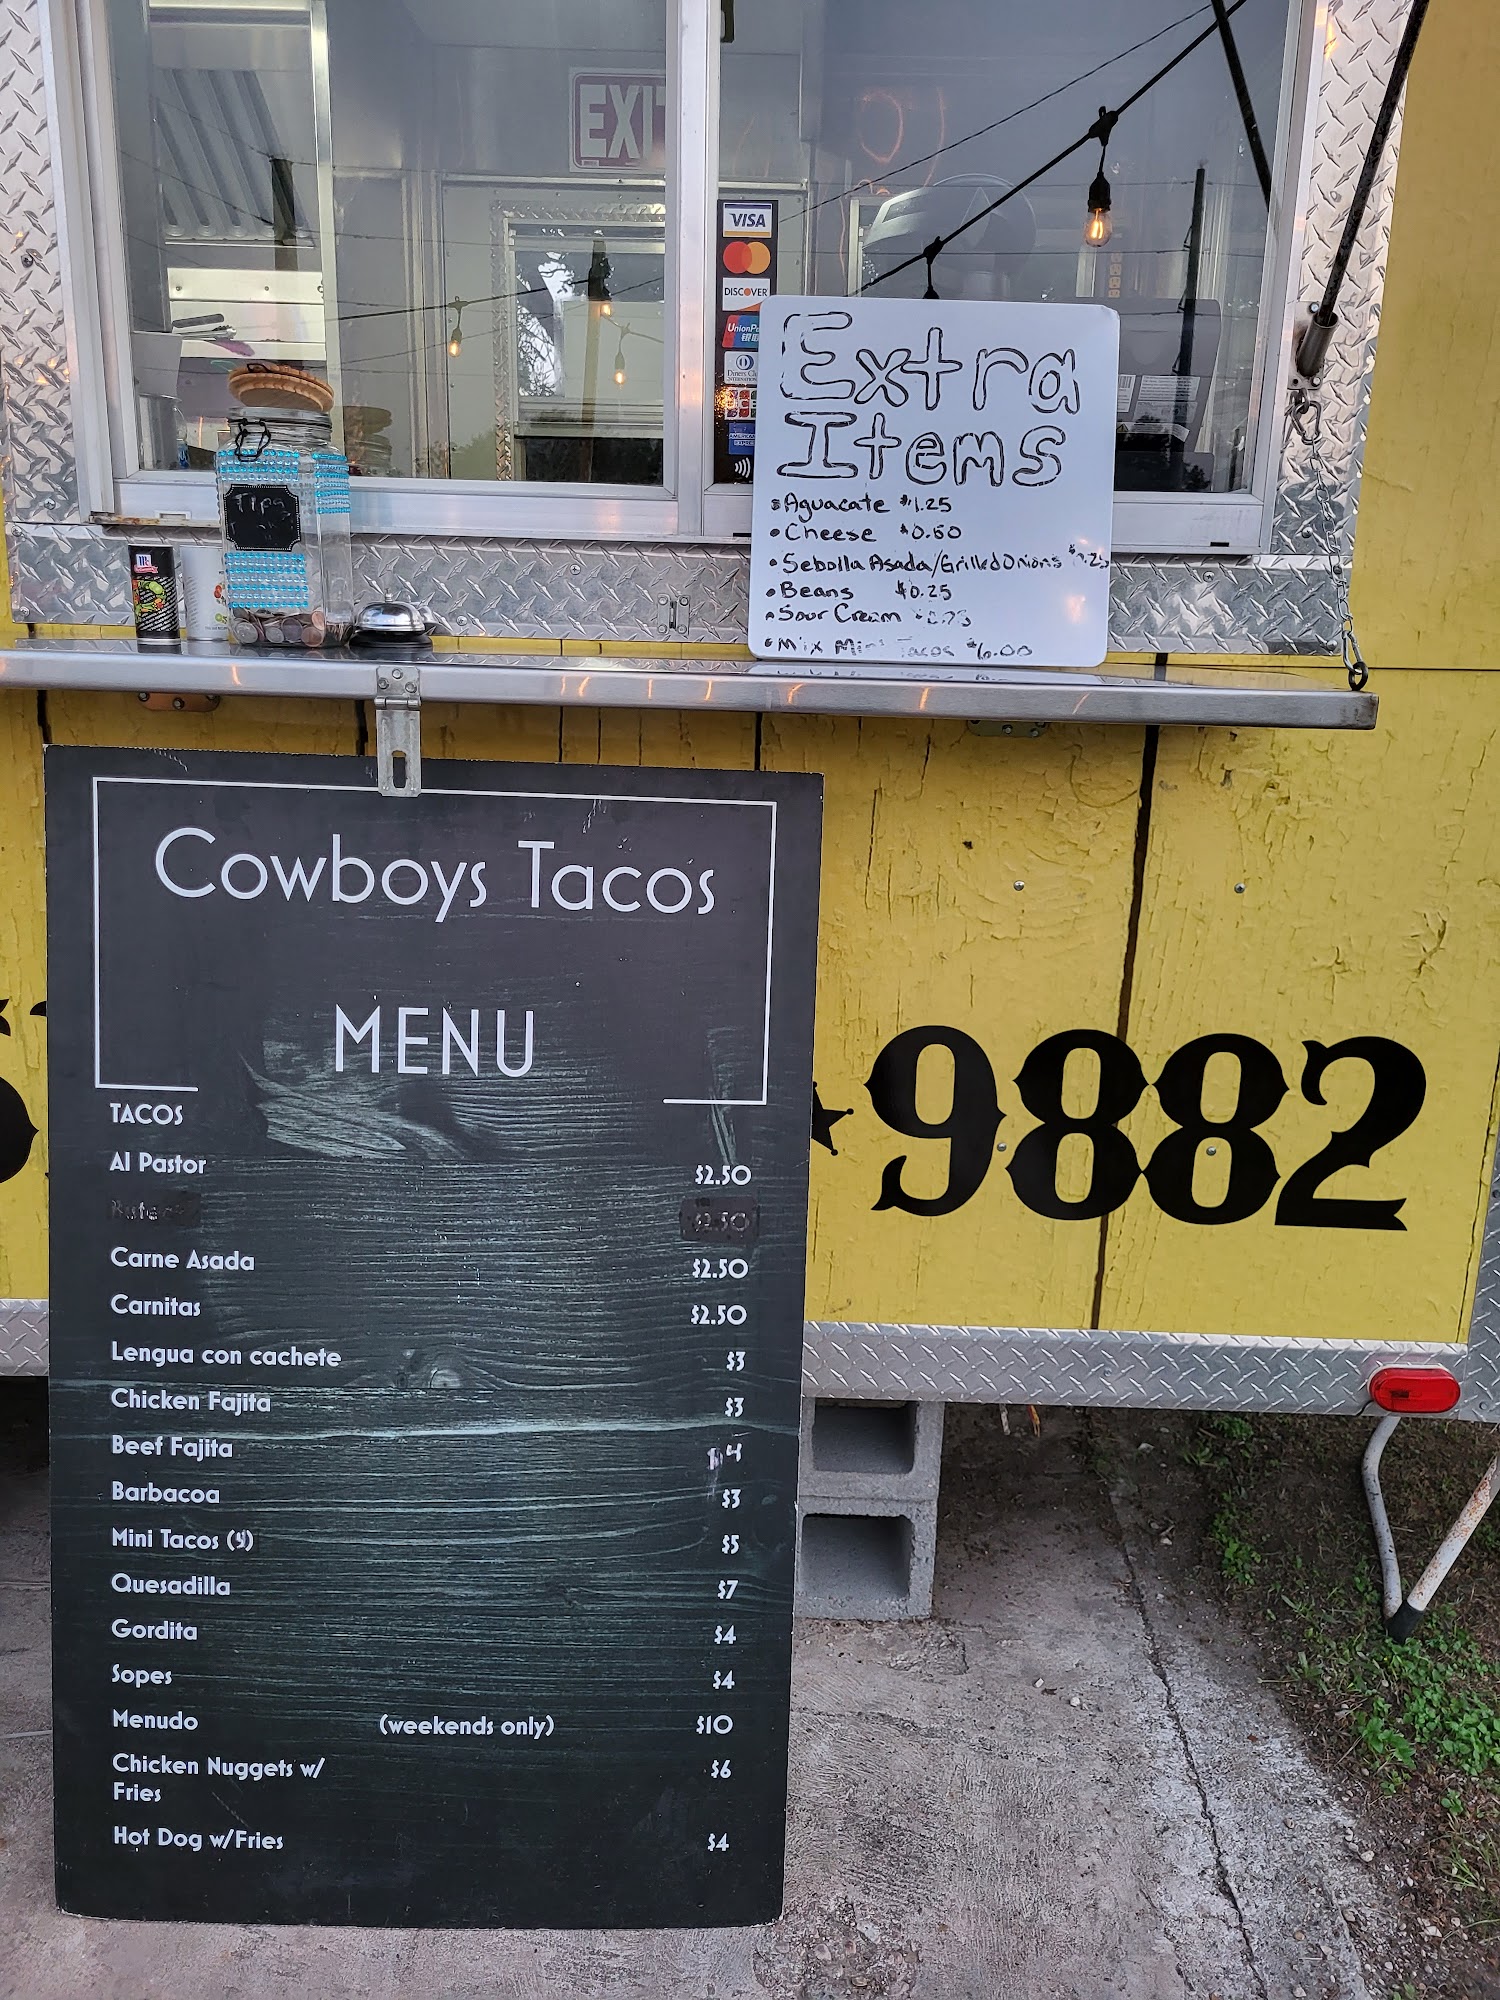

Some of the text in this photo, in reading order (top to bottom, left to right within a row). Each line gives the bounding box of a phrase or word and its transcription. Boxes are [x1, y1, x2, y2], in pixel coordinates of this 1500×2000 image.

[729, 213, 766, 228] VISA
[724, 287, 768, 297] DISCOVER
[780, 312, 1080, 415] Extra
[777, 411, 1070, 487] Items
[784, 493, 890, 524] Aguacate
[785, 522, 876, 542] Cheese
[783, 553, 865, 573] Sebolla
[780, 580, 951, 600] Beans $0.25
[779, 604, 828, 621] Sour
[834, 603, 901, 623] Cream
[156, 828, 714, 922] Cowboys Tacos
[336, 1005, 533, 1077] MENU
[110, 1103, 182, 1125] TACOS
[864, 1024, 1427, 1232] 9882
[110, 1152, 206, 1173] Al Pastor
[696, 1165, 751, 1185] $2.50
[111, 1247, 254, 1270] Carne Asada
[693, 1259, 748, 1278] $2.50
[111, 1294, 200, 1316] Carnitas
[691, 1305, 746, 1324] $2.50
[113, 1341, 341, 1367] Lengua con cachete
[727, 1352, 745, 1371] $3
[112, 1388, 272, 1415] Chicken Fajita
[725, 1398, 744, 1417] $3
[113, 1435, 235, 1461] Beef Fajita
[113, 1481, 219, 1503] Barbacoa
[722, 1490, 740, 1508] $3
[113, 1528, 152, 1547] Mini
[161, 1529, 218, 1549] Tacos
[722, 1535, 739, 1553] $5
[112, 1573, 229, 1595] Quesadilla
[718, 1581, 738, 1599] $7
[112, 1619, 196, 1639] Gordita
[715, 1626, 736, 1644] $4
[112, 1664, 171, 1687] Sopes
[713, 1671, 734, 1689] $4
[114, 1710, 554, 1739] Menudo (weekends only)
[697, 1715, 732, 1733] $10
[113, 1754, 325, 1780] Chicken Nuggets w/
[712, 1760, 731, 1778] $6
[114, 1782, 160, 1801] Fries
[115, 1826, 283, 1851] Hot Dog w/Fries
[708, 1833, 729, 1851] $4
